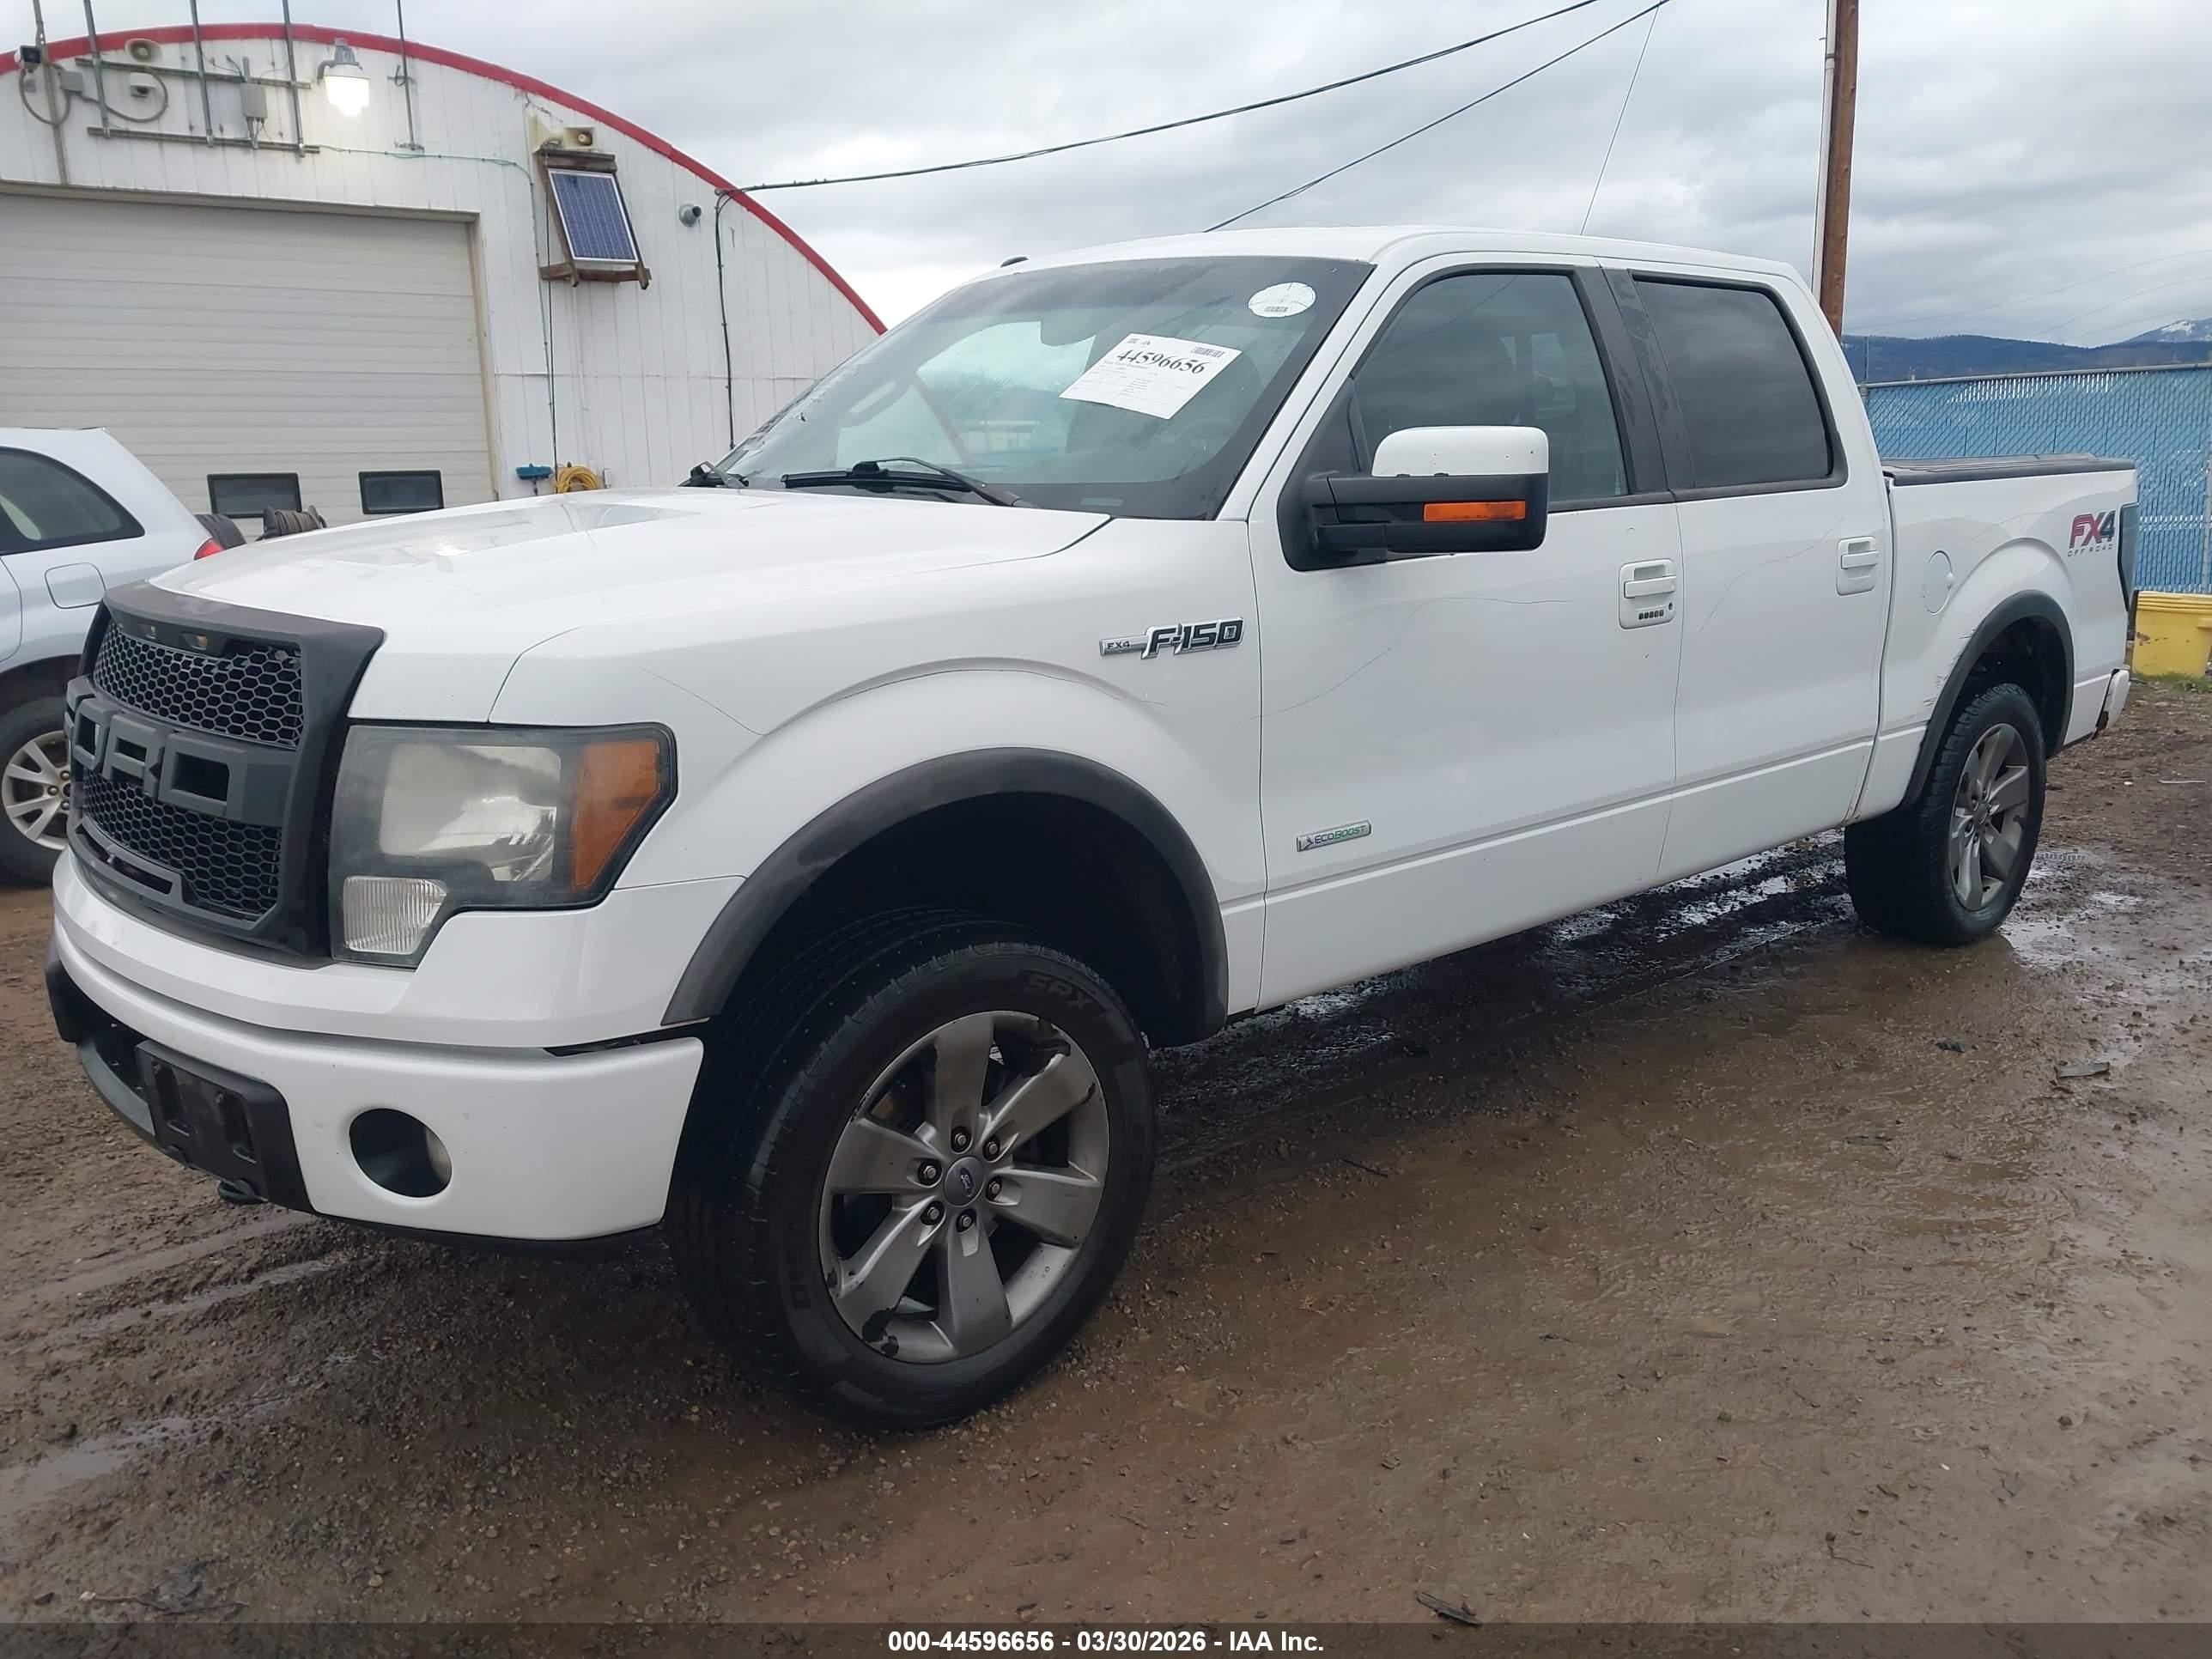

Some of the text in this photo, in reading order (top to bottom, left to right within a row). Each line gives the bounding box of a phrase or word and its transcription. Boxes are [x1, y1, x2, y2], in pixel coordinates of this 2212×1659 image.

[1117, 349, 1209, 374] 44596656
[2069, 509, 2117, 549] FX4
[1107, 616, 1244, 659] FX4 F-150
[1314, 824, 1367, 844] ECOBOOST
